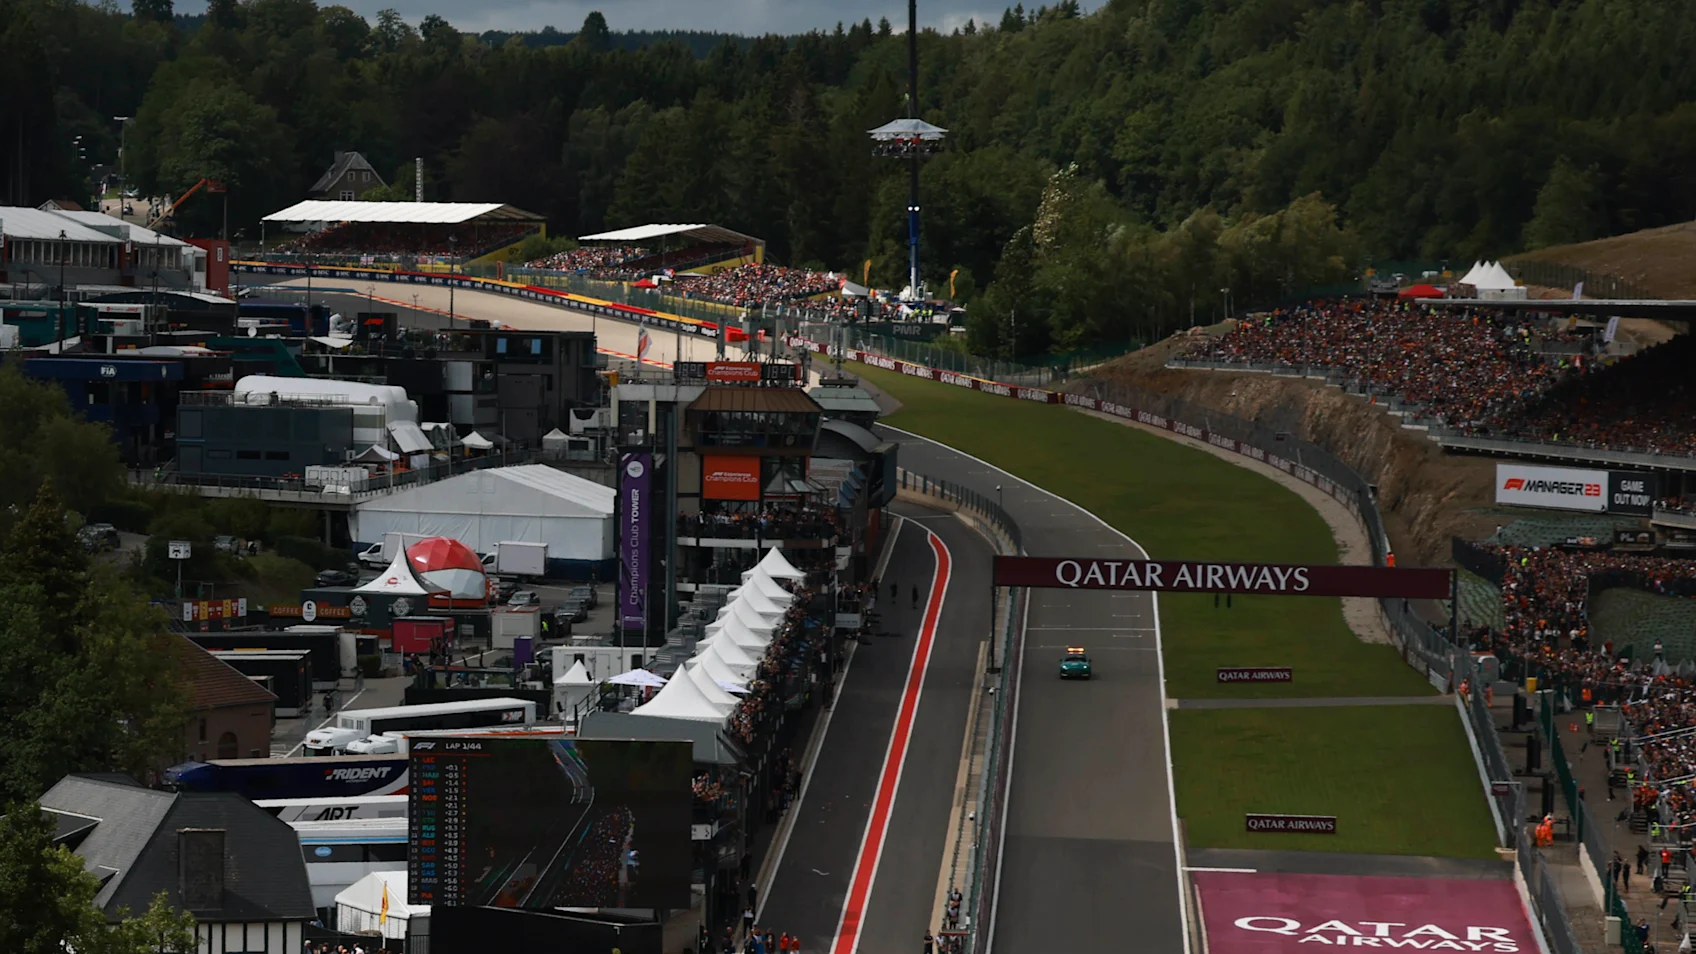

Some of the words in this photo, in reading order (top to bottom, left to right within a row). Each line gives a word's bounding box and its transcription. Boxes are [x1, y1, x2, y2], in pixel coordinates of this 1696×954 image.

[892, 325, 922, 336] PMR
[743, 370, 759, 378] Club
[1524, 480, 1584, 496] MANAGER
[1585, 484, 1601, 497] 23
[1620, 480, 1644, 492] GAME
[1614, 493, 1629, 505] OUT
[630, 488, 640, 524] TOWER
[629, 524, 640, 548] Club
[629, 549, 640, 605] Champions
[1056, 560, 1165, 588] QATAR
[1173, 564, 1311, 591] AIRWAYS
[272, 606, 299, 615] COFFEE
[319, 608, 345, 616] COFFEE
[1219, 671, 1250, 681] QATAR
[1251, 671, 1291, 680] AIRWAYS
[445, 742, 461, 750] LAP
[462, 742, 482, 750] 1/44
[1248, 819, 1286, 830] QATAR
[1286, 820, 1334, 830] AIRWAYS
[1234, 916, 1517, 943] QATAR
[1299, 934, 1519, 953] AIRWAYS
